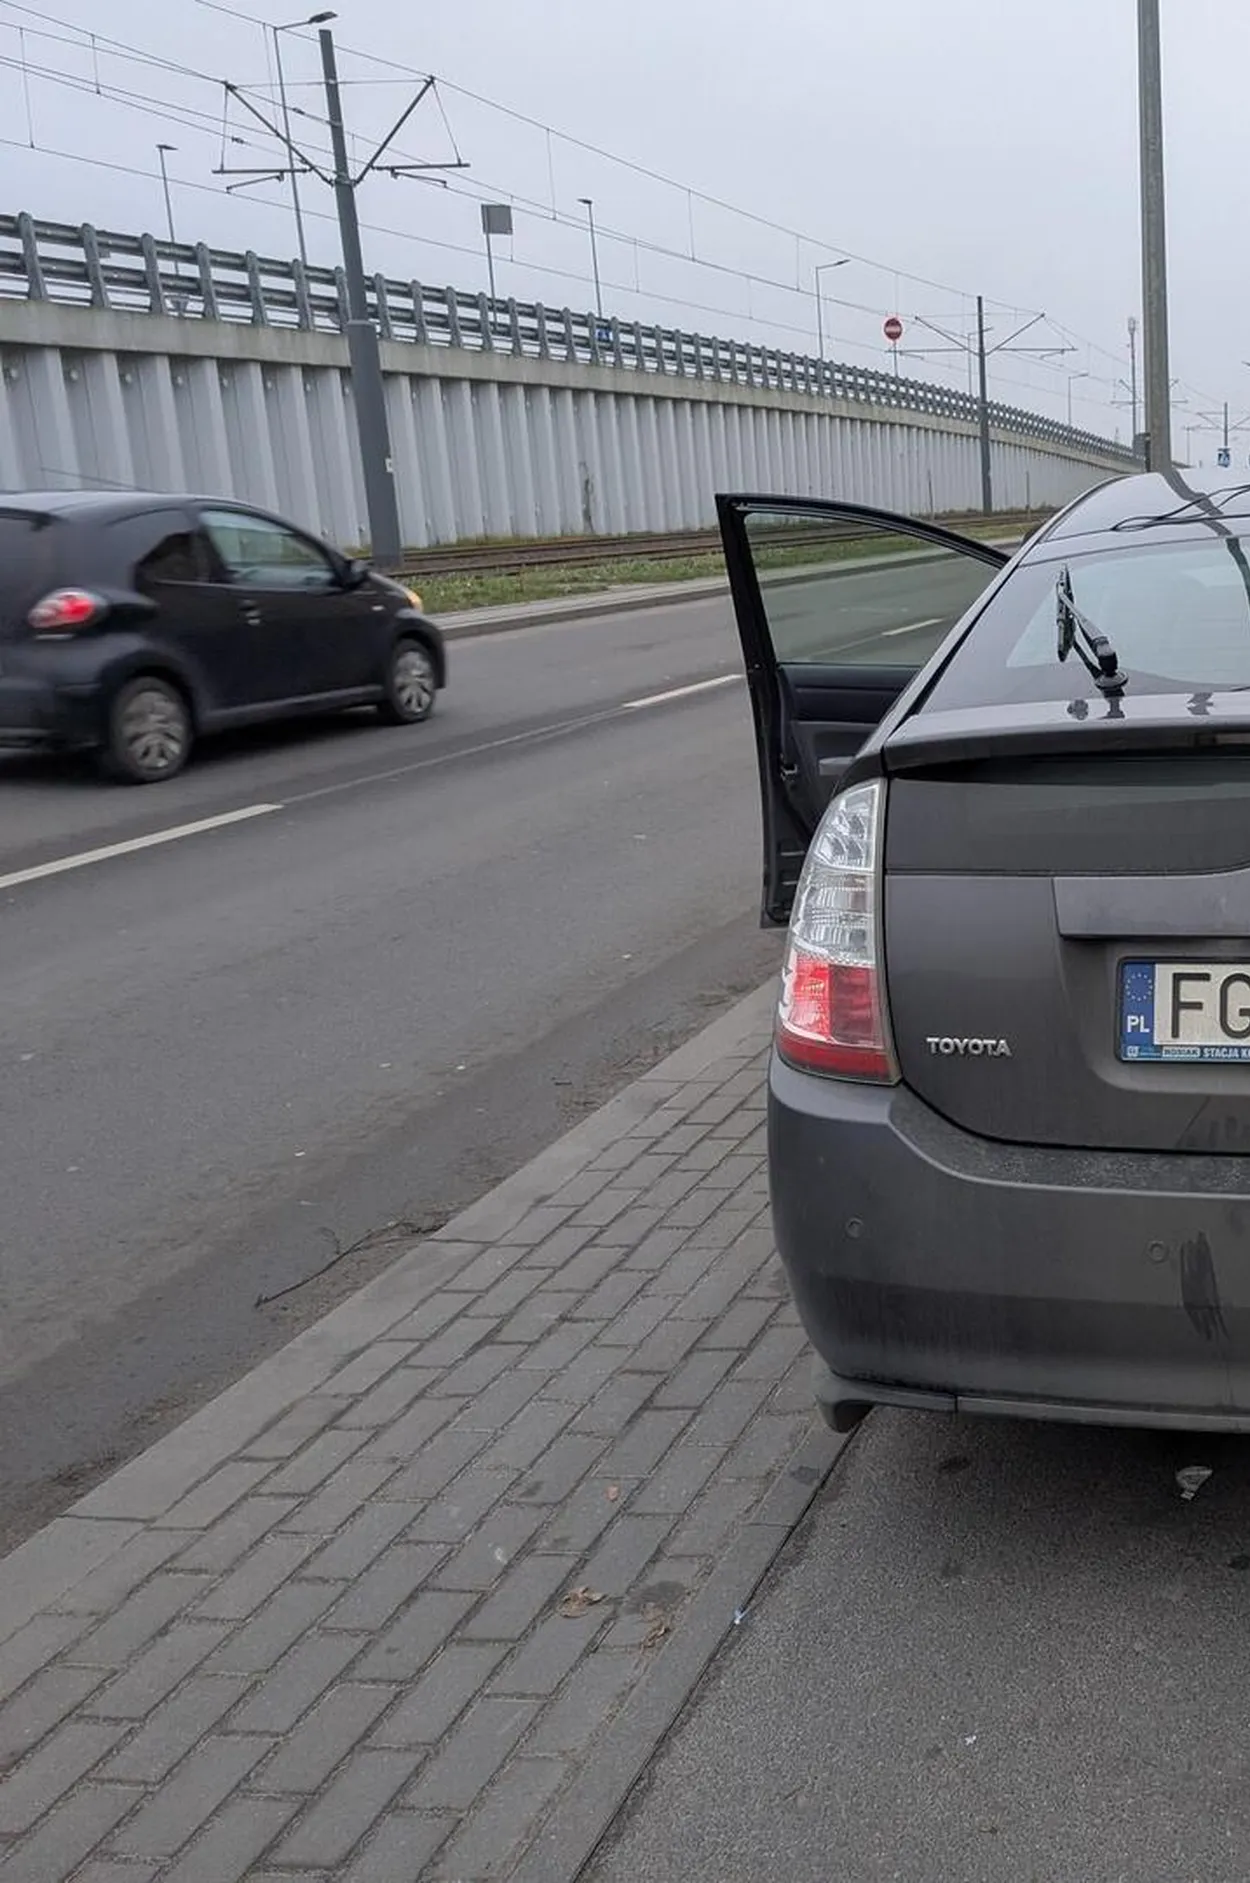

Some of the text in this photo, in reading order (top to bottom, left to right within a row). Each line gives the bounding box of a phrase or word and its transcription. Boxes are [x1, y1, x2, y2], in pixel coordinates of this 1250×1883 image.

[1127, 1015, 1150, 1033] PL
[926, 1037, 1012, 1057] TOYOTA
[1202, 1047, 1240, 1059] STACJA
